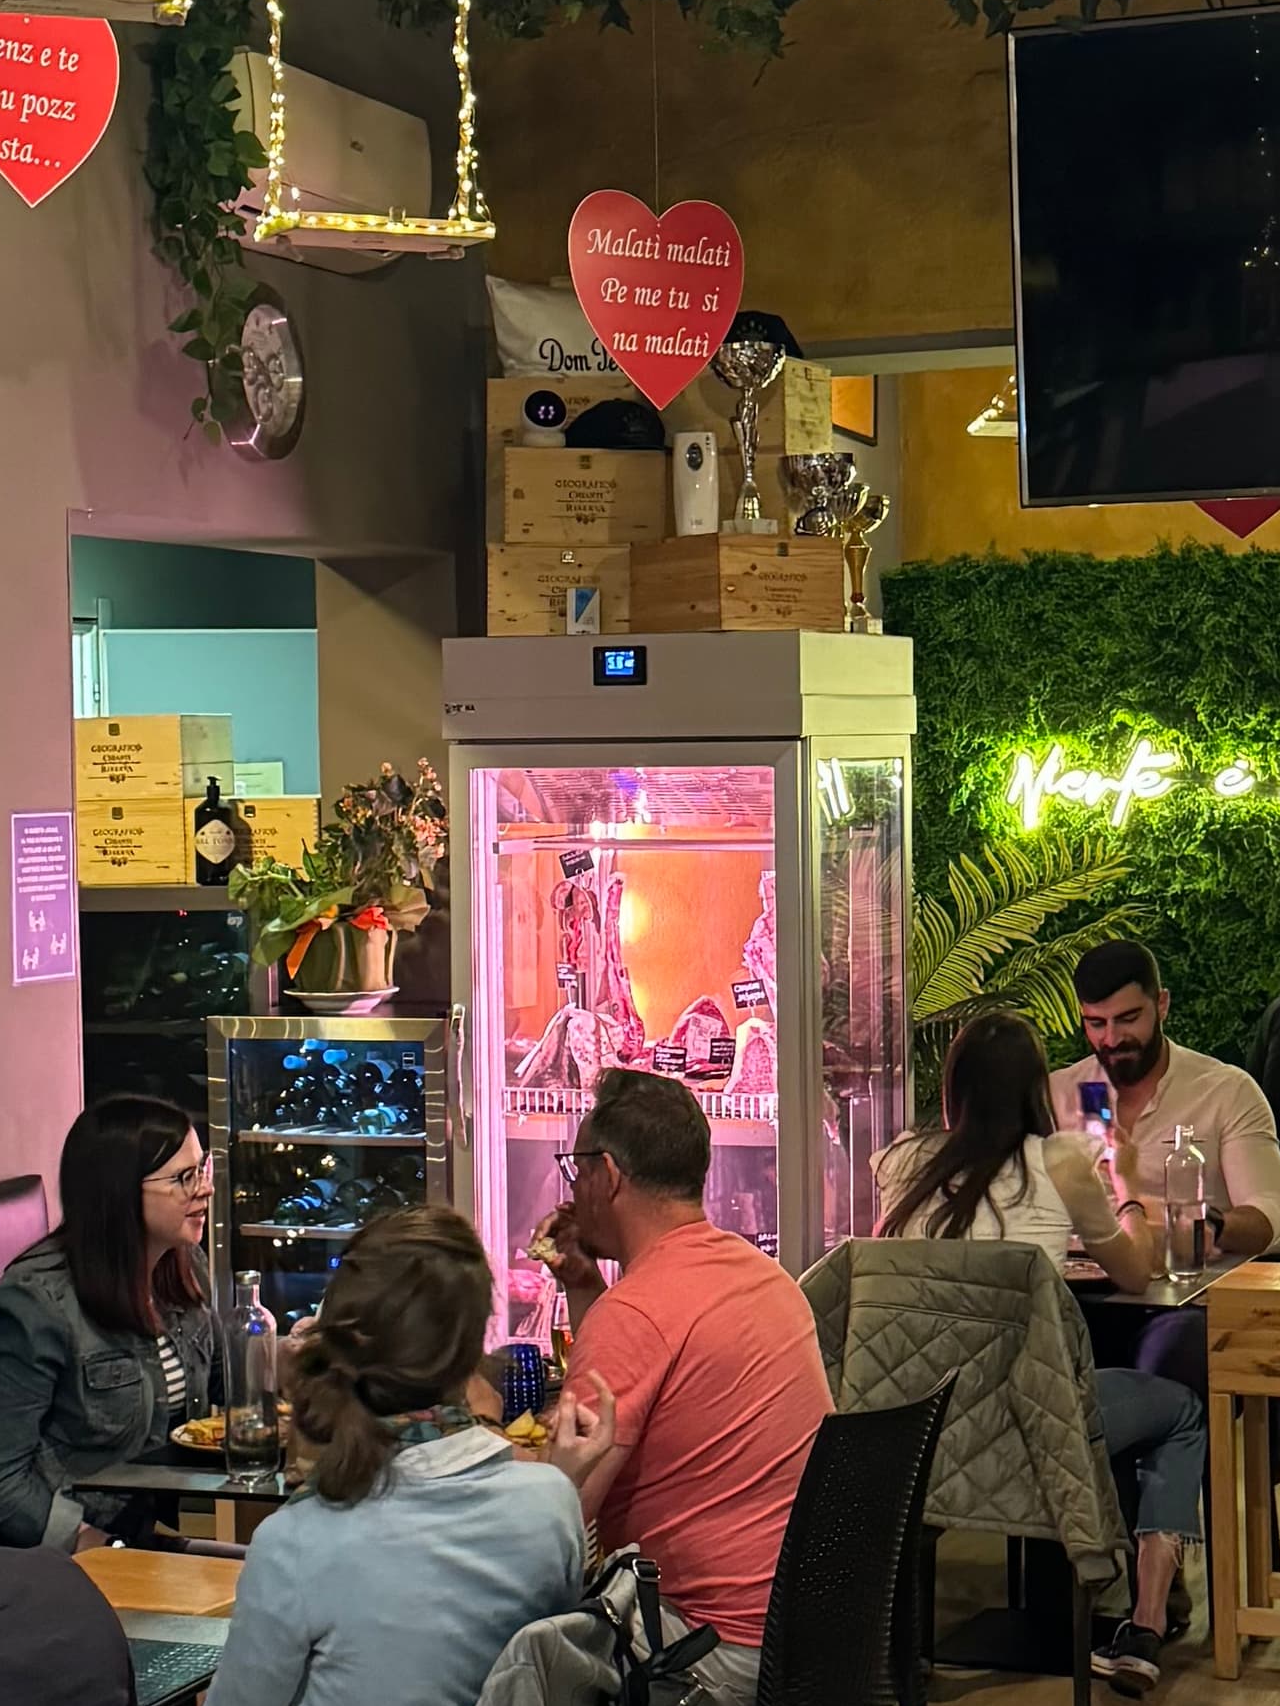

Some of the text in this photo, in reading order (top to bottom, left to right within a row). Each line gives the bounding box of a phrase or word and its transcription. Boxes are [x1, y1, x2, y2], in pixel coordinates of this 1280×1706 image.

[40, 47, 51, 66] e
[59, 47, 80, 72] te
[20, 92, 77, 123] pozz
[0, 137, 61, 169] sta...
[587, 228, 731, 267] Malatì malatì
[601, 277, 720, 312] Pe me tu si
[539, 338, 592, 372] Dom
[612, 327, 709, 358] na malatì
[1007, 738, 1177, 831] Niente
[1214, 757, 1254, 795] è
